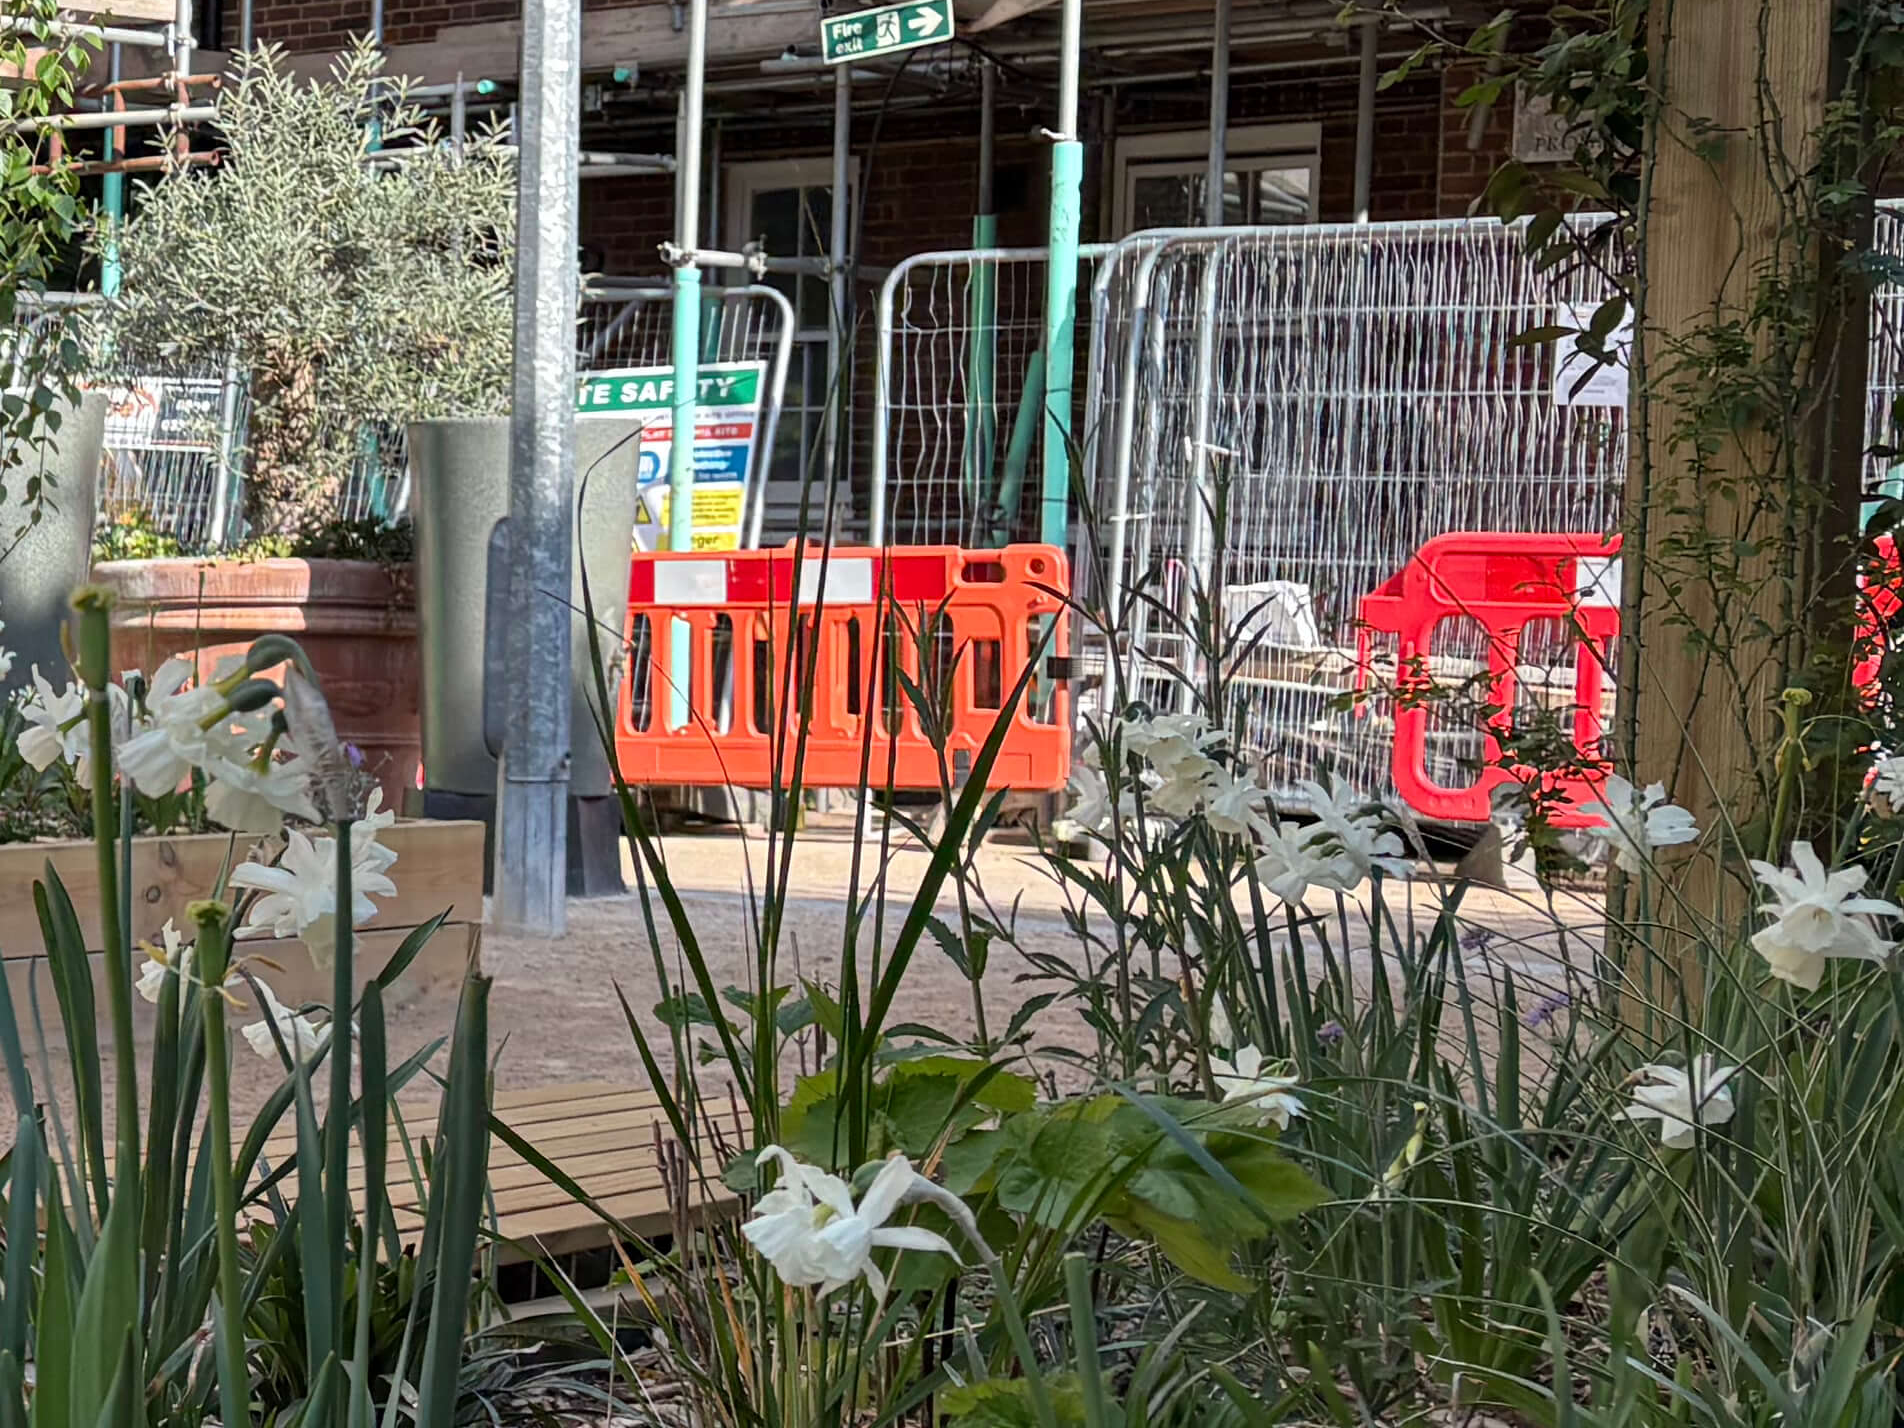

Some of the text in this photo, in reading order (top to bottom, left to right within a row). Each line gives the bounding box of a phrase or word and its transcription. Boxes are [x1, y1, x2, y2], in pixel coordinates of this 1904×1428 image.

[832, 22, 863, 40] Fire
[835, 37, 863, 54] exit
[578, 376, 736, 406] TE SAFTY
